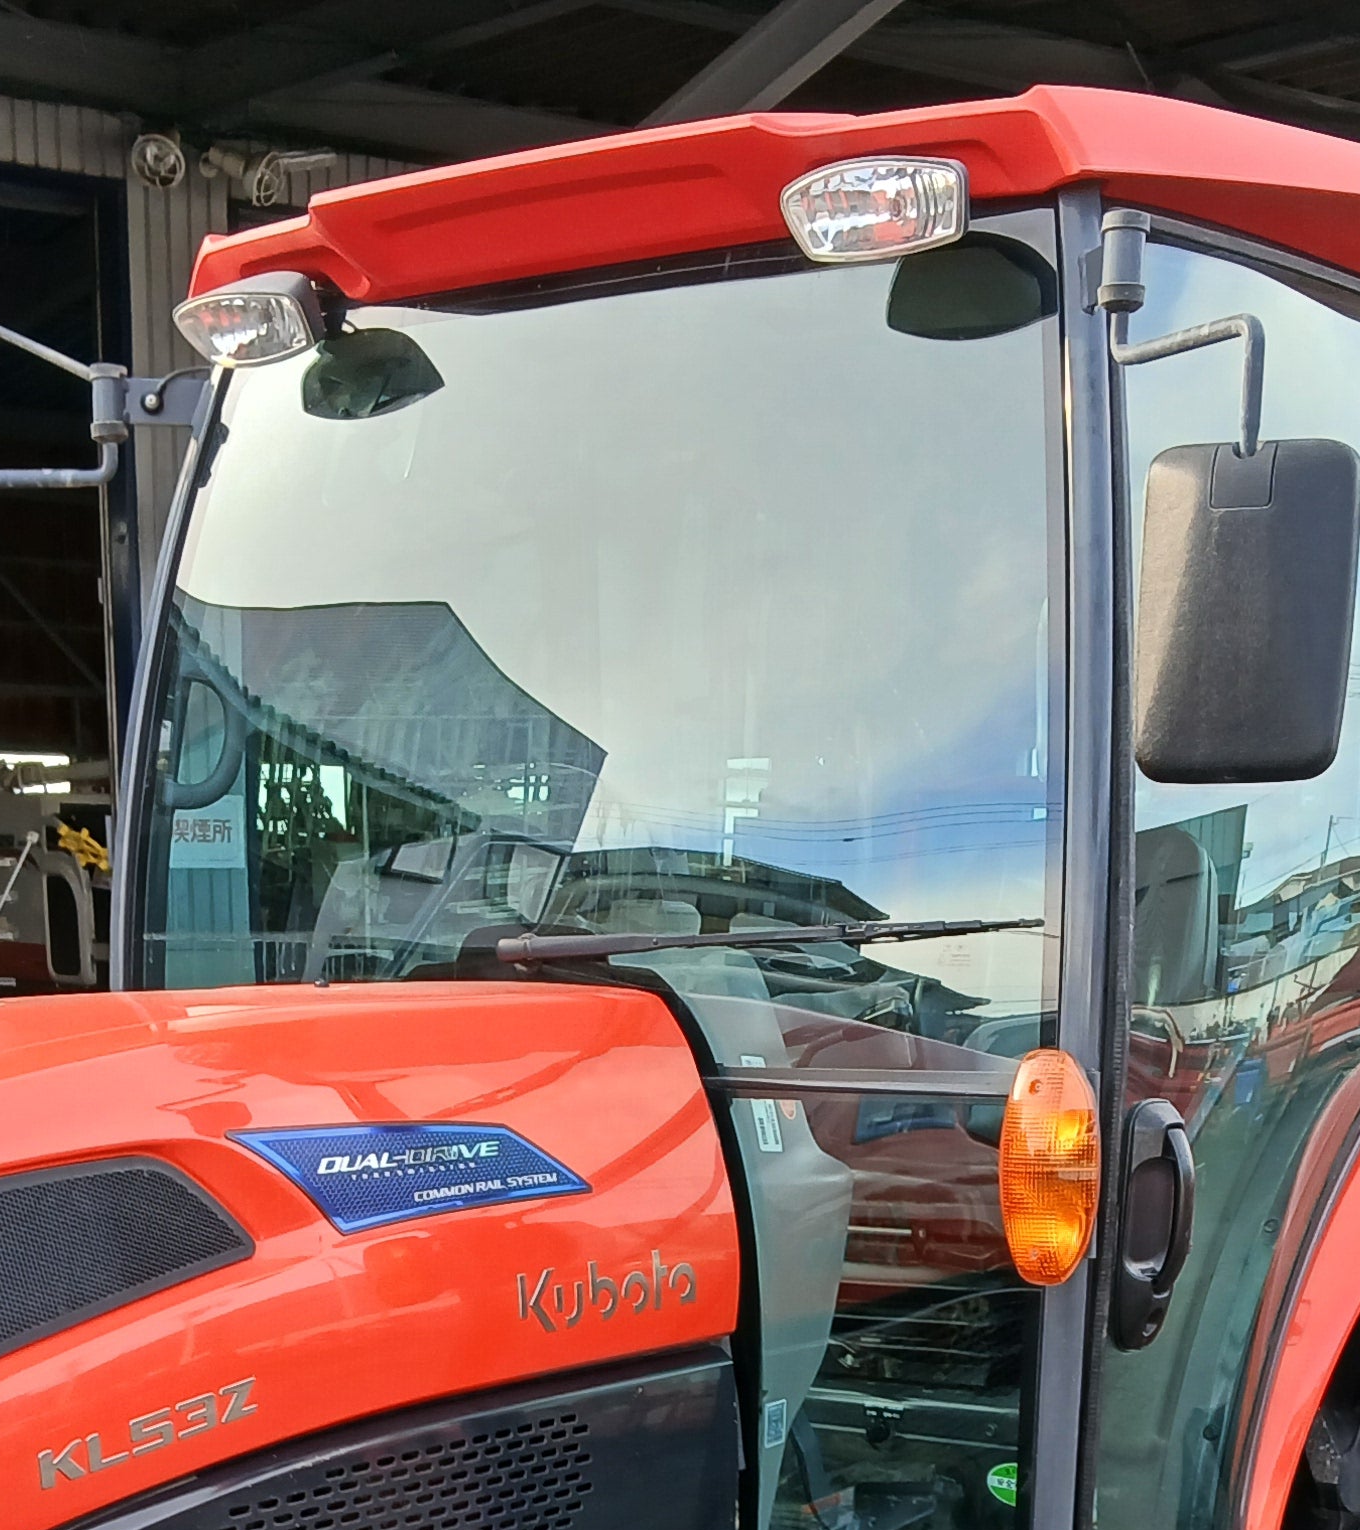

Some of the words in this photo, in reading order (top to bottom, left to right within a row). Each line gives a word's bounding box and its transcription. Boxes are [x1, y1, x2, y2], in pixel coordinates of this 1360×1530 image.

[413, 1183, 474, 1202] COMMON
[475, 1179, 507, 1192] RAIL
[506, 1172, 558, 1188] SYSTEM
[516, 1248, 697, 1333] Kubota
